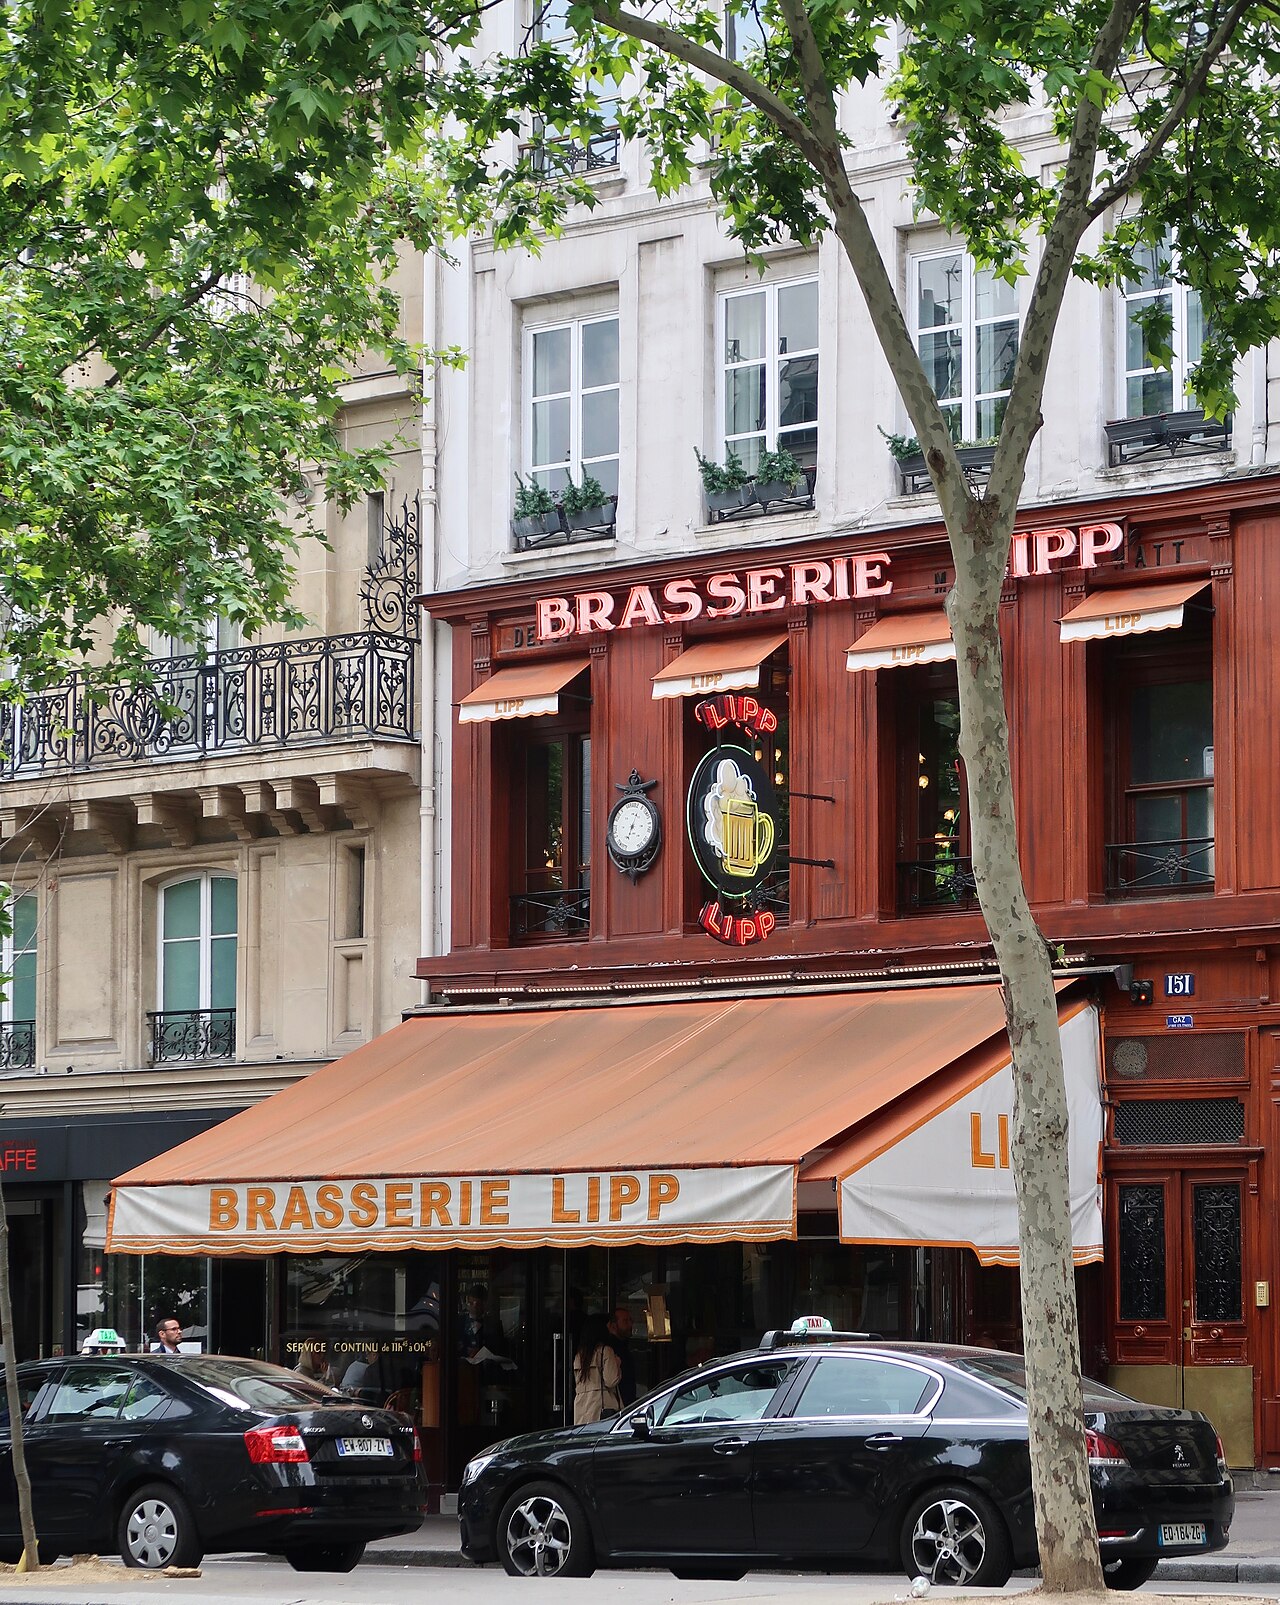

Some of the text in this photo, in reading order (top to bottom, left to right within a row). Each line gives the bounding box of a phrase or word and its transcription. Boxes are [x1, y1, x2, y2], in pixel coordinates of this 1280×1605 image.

[536, 522, 1124, 640] BRASSERIE IPP
[1104, 612, 1141, 631] LIPP
[891, 644, 926, 661] LIPP
[690, 672, 723, 689] LIPP
[494, 699, 524, 714] LIPP
[705, 694, 777, 731] LIPP
[707, 902, 775, 944] LIPP
[1167, 974, 1190, 994] 151
[971, 1112, 1010, 1169] LI
[208, 1173, 680, 1232] BRASSERIE LIPP
[806, 1318, 822, 1328] TAXI
[99, 1330, 116, 1340] TAXI
[286, 1342, 326, 1353] SERVICE
[334, 1342, 378, 1353] CONTINU
[381, 1342, 390, 1353] de
